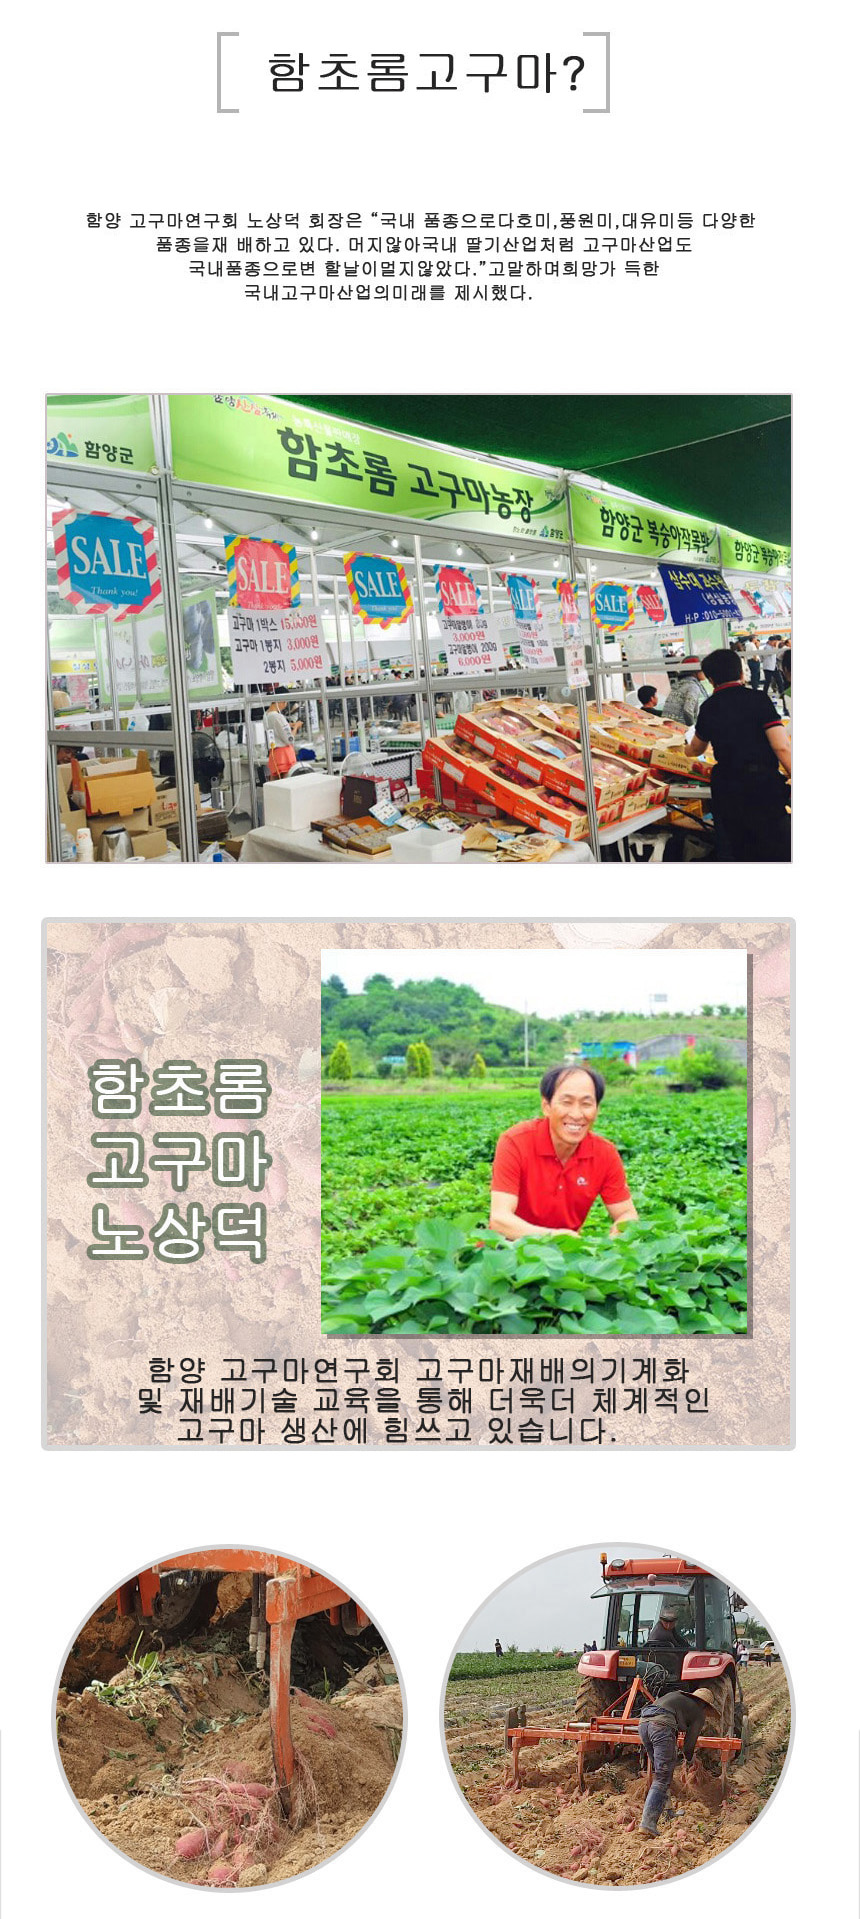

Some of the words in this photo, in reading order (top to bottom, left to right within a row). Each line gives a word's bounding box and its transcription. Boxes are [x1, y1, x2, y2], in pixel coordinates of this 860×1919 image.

[83, 440, 135, 465] 함양군
[276, 426, 399, 498] 함초롬
[409, 461, 535, 524] 고구마농장
[599, 506, 644, 544] 함양군
[646, 518, 710, 555] 복숭아작목반
[70, 535, 148, 580] SALE
[733, 539, 760, 564] 함양군
[236, 555, 290, 595] SALE
[353, 569, 402, 600] SALE
[90, 586, 118, 596] Thank
[120, 588, 139, 598] you!
[441, 579, 478, 608] SALE
[595, 590, 627, 614] SALE
[640, 593, 665, 614] SALE
[232, 615, 254, 632] 고구마
[256, 617, 278, 633] 1박스
[452, 630, 486, 642] 3,000원
[234, 638, 258, 653] 고구마
[259, 638, 283, 654] 1봉지
[286, 635, 320, 652] 3,000원
[481, 641, 498, 653] 200g
[263, 659, 286, 675] 2봉지
[289, 655, 323, 672] 5,000원
[457, 653, 492, 667] 6,000원
